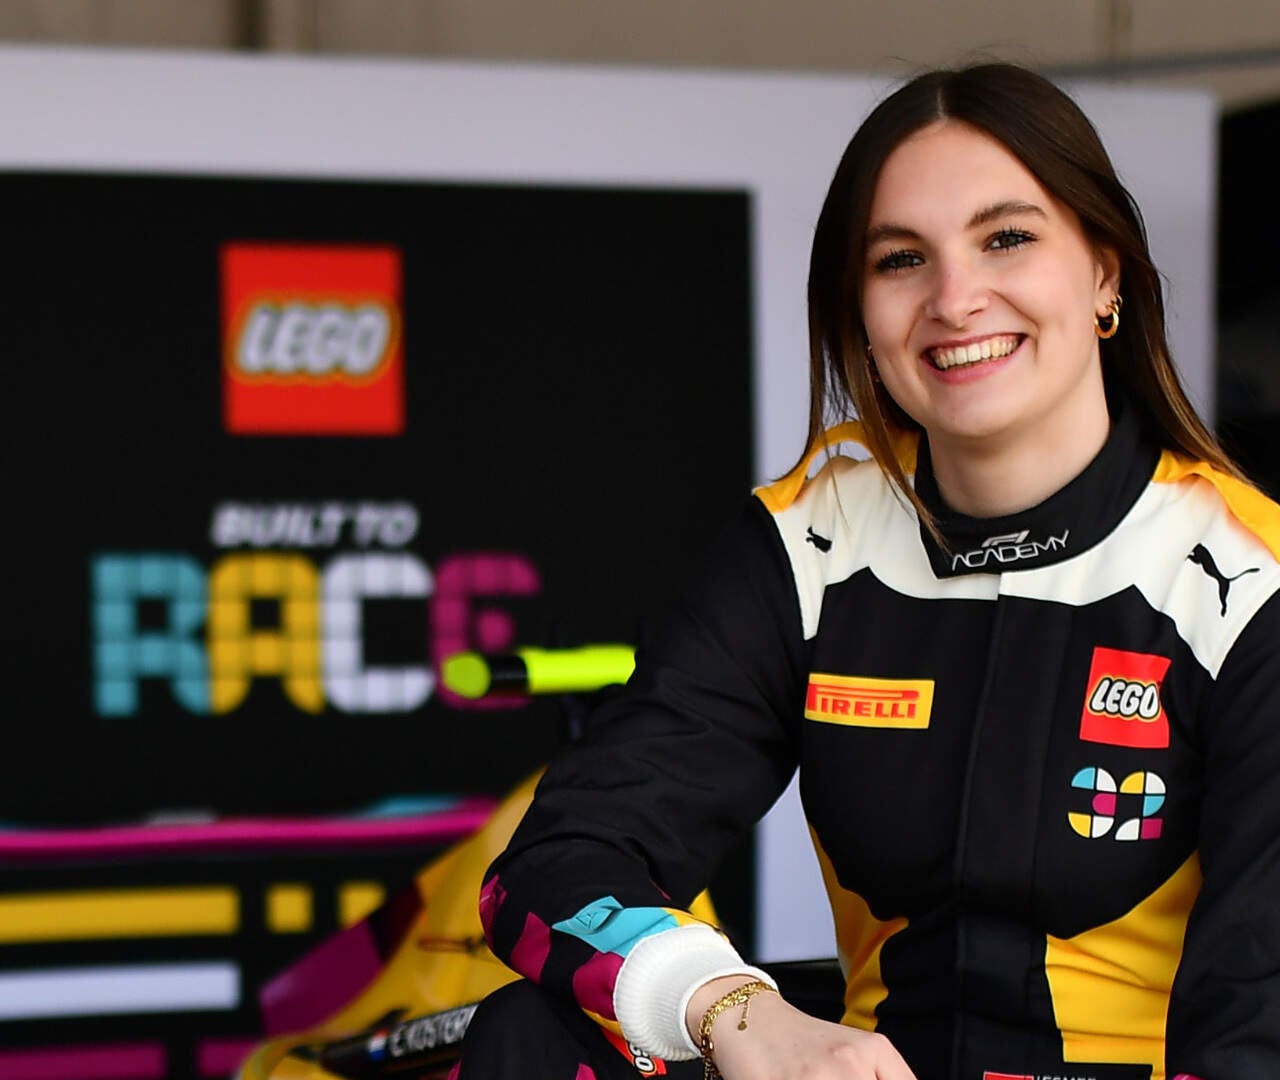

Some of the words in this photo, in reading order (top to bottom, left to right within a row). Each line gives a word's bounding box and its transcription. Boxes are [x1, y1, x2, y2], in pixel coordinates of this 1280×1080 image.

[234, 300, 394, 376] LEGO
[212, 502, 344, 547] BUILT
[353, 502, 420, 548] TO
[951, 529, 1070, 572] ACADEMY
[91, 551, 540, 716] RACE
[806, 682, 920, 719] PIRELLI
[1091, 678, 1160, 718] LEGO
[1068, 766, 1167, 841] 32
